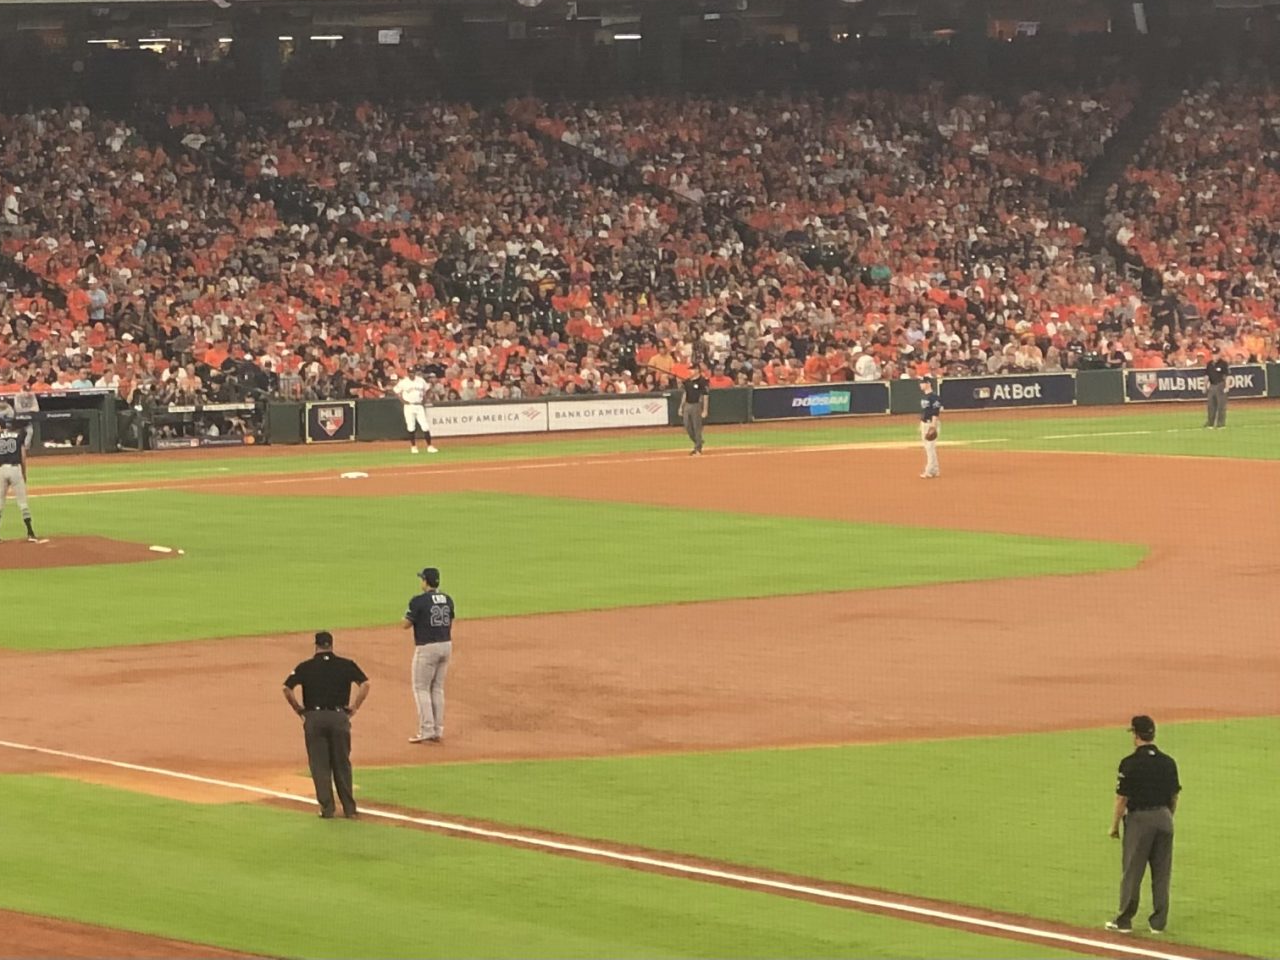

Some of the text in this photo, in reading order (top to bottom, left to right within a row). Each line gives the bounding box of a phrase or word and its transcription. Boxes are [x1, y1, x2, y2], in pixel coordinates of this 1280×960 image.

[1159, 377, 1186, 391] MLB
[792, 396, 849, 407] DOOSAN
[432, 417, 458, 425] BANK
[476, 413, 520, 423] AMERICA
[555, 411, 581, 419] BANK
[598, 407, 641, 416] AMERICA
[430, 605, 451, 627] 26
